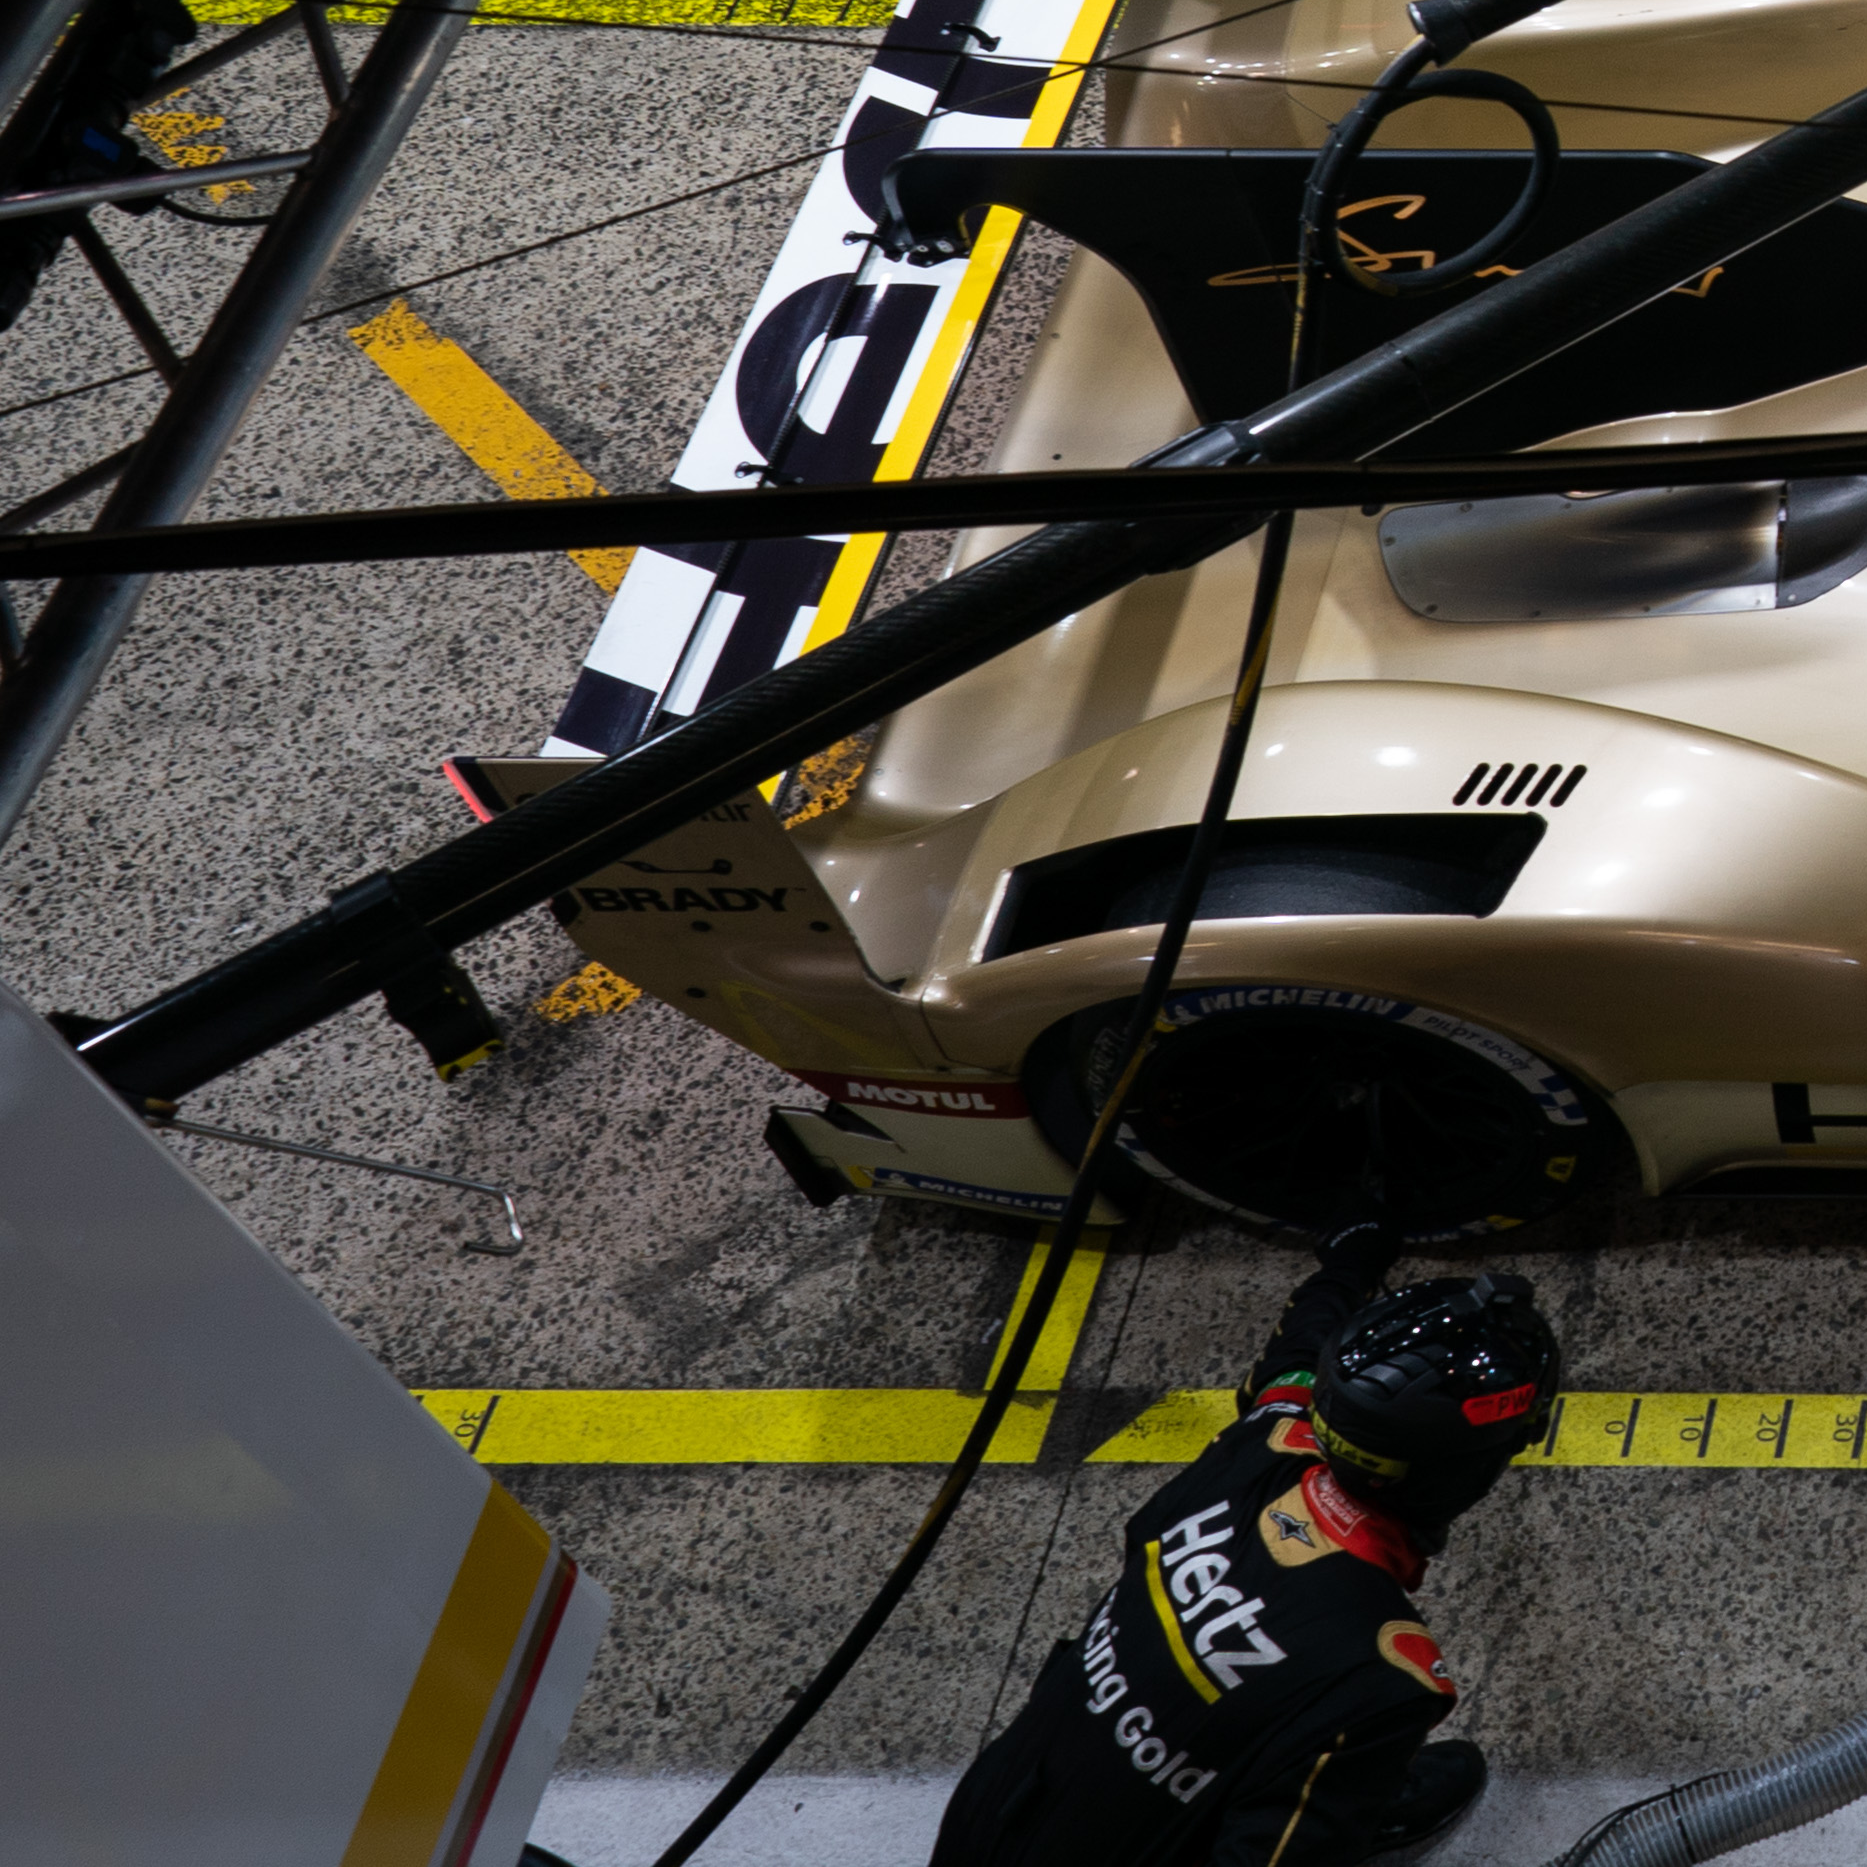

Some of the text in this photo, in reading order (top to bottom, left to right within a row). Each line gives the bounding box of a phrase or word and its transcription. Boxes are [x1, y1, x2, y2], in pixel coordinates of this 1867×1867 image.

[576, 888, 788, 912] BRADY
[1199, 988, 1398, 1018] MICHELIN
[846, 1081, 997, 1112] MOTUL
[919, 1179, 1065, 1212] MICHELIN
[1161, 1500, 1288, 1691] Hertz
[1083, 1586, 1218, 1804] cing Gold
